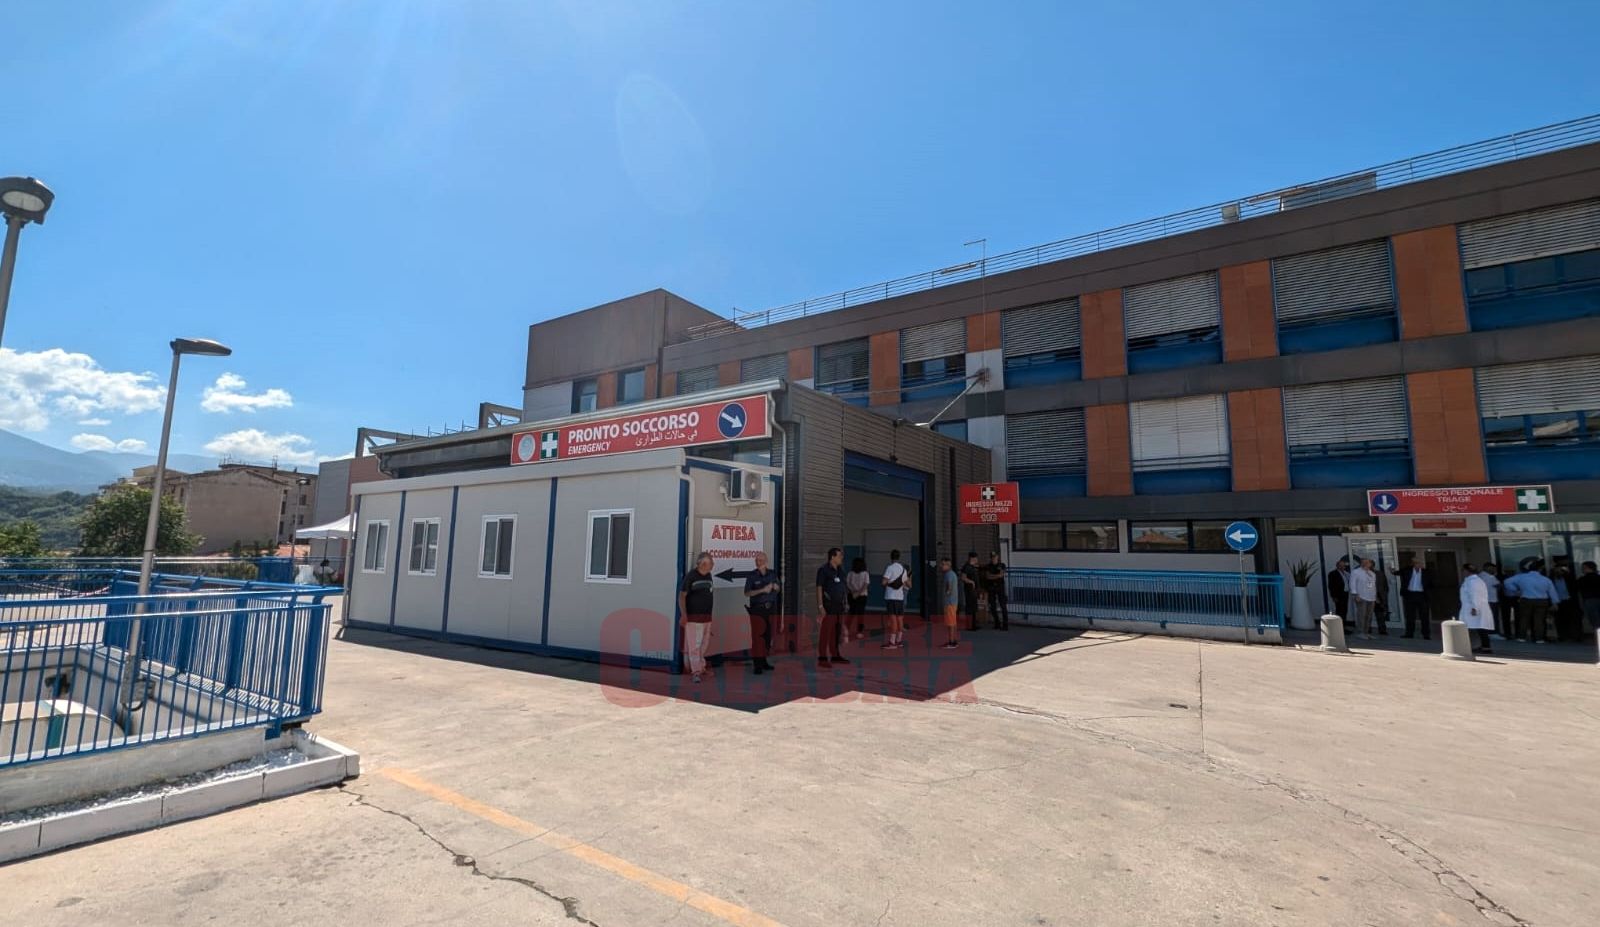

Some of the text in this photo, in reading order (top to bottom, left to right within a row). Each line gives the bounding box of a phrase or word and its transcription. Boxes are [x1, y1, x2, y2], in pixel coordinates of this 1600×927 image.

[568, 411, 700, 444] PRONTO SOCCORSO
[664, 429, 686, 440] حالات
[687, 429, 698, 441] في
[567, 441, 611, 455] EMERGENCY
[1451, 488, 1503, 496] PEDONALE
[711, 524, 757, 541] ATTESA
